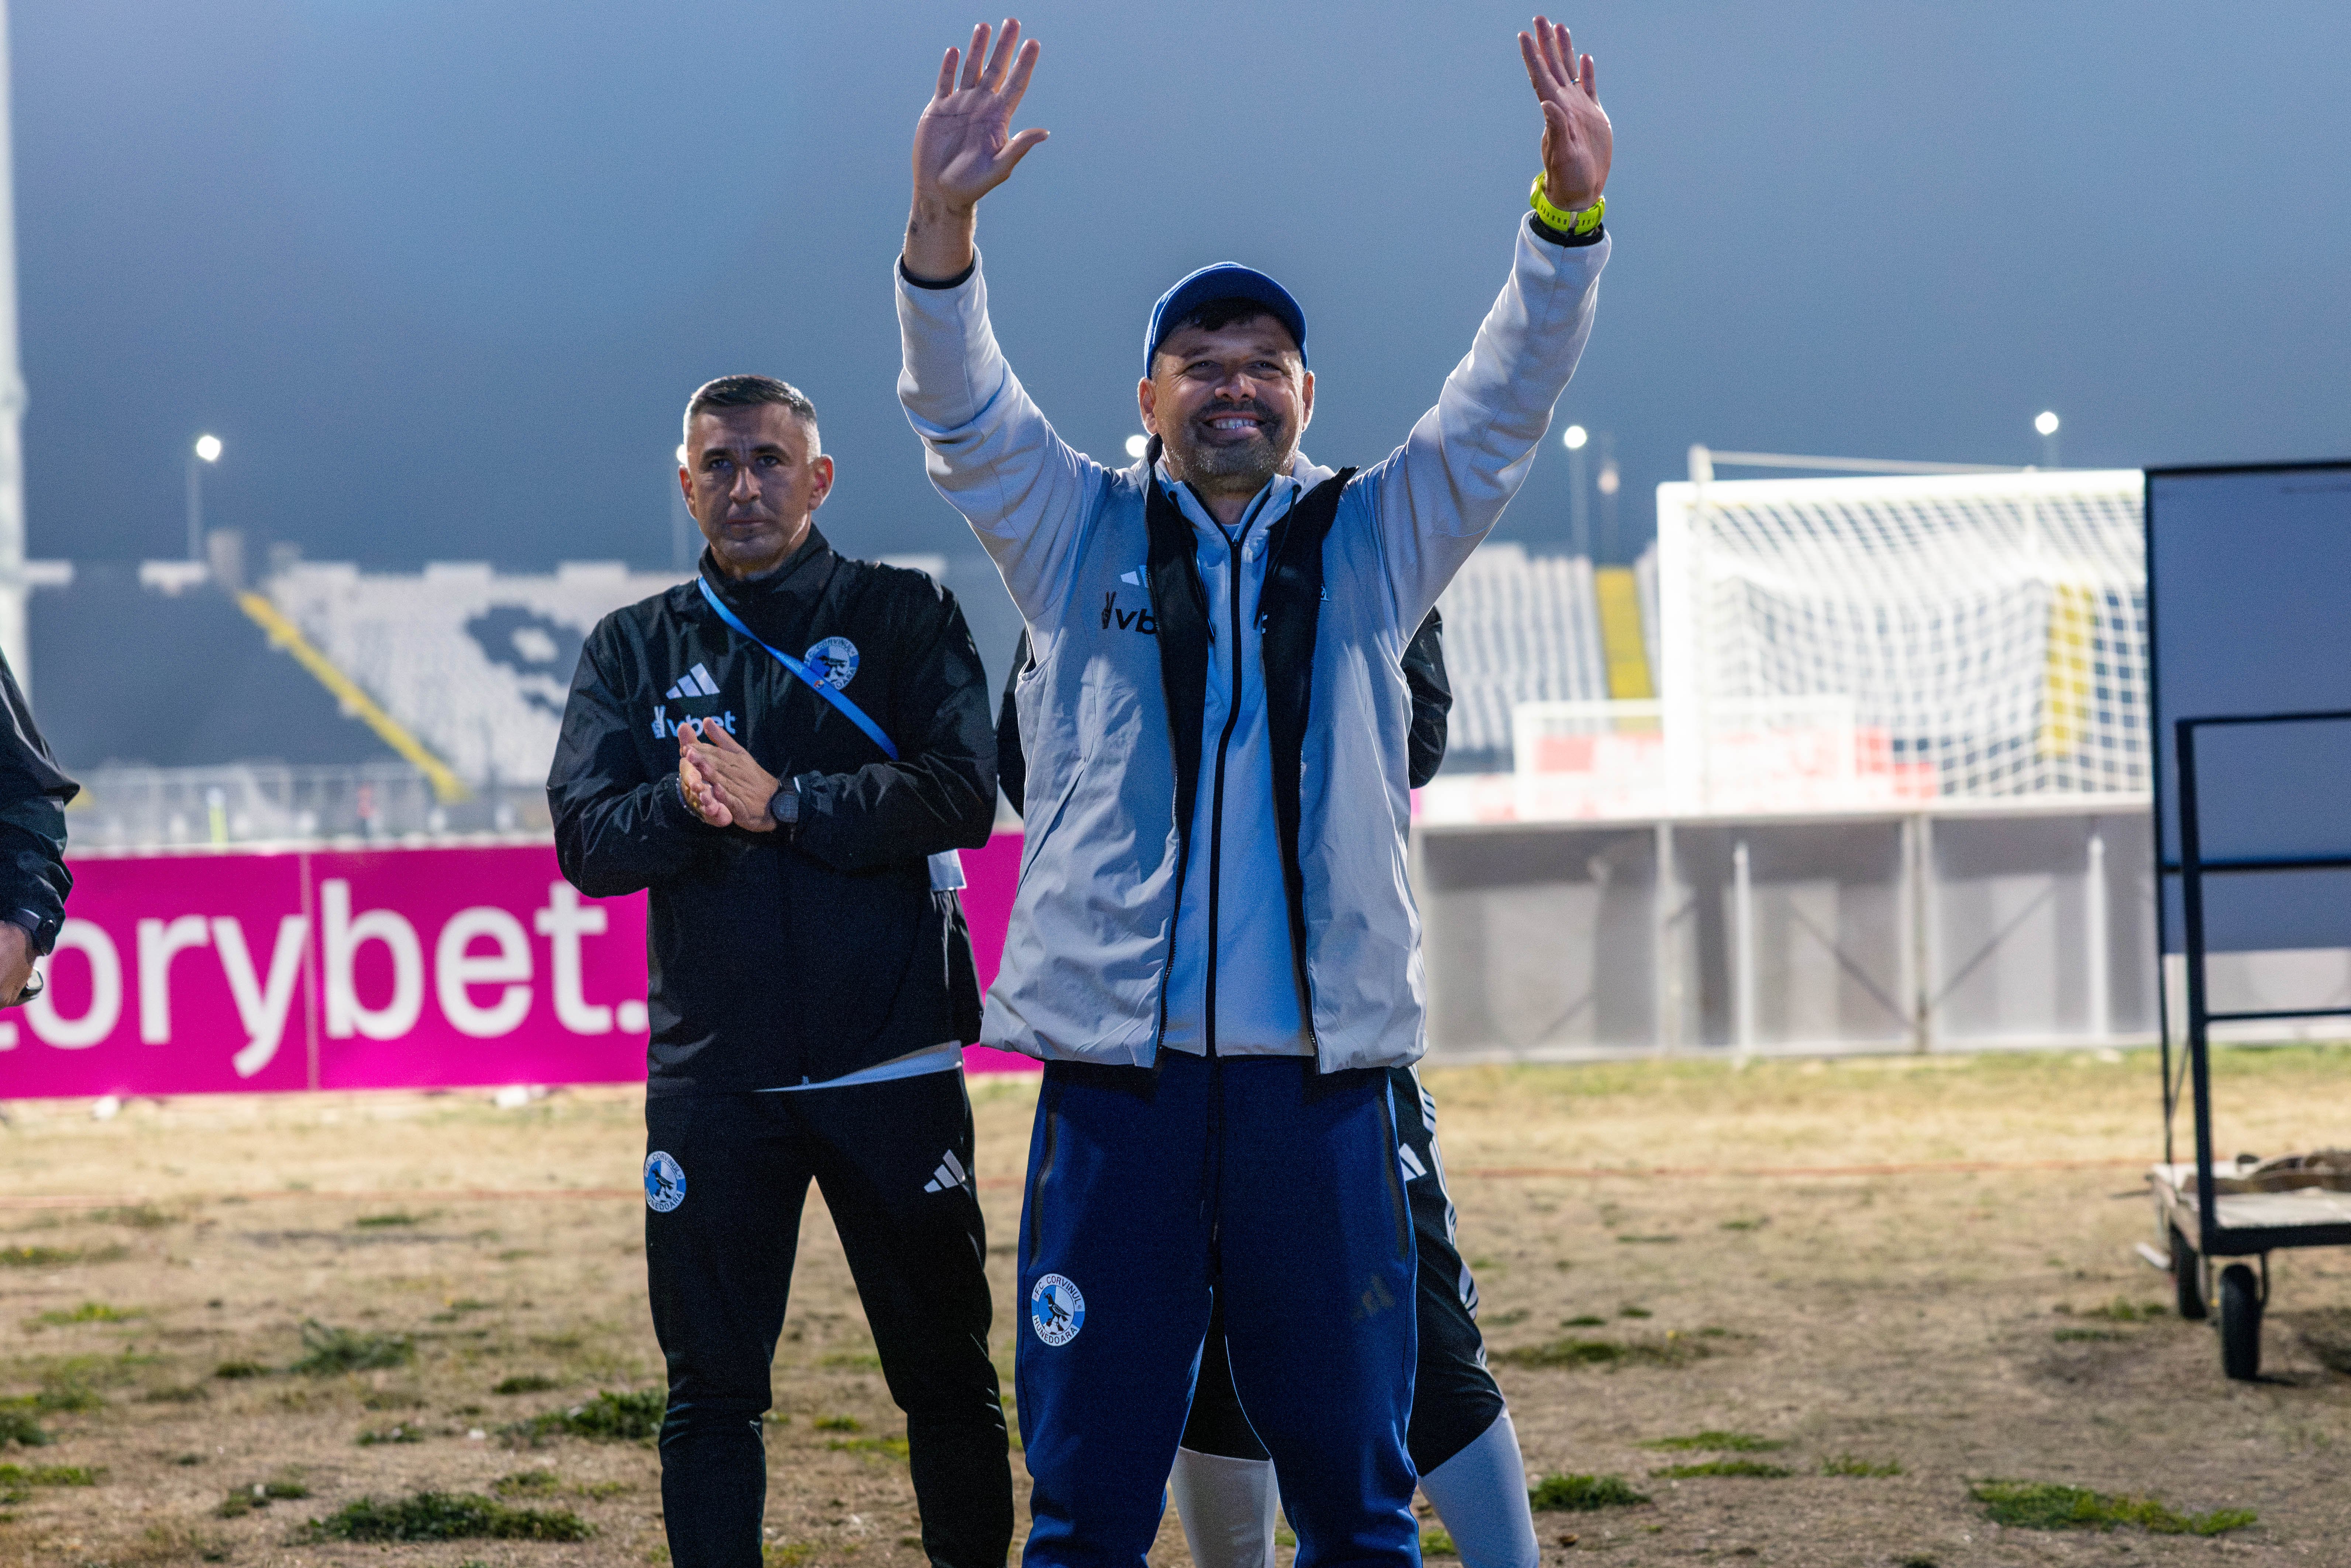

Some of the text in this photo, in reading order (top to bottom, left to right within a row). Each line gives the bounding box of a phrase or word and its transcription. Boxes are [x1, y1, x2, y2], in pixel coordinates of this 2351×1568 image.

[0, 878, 648, 1077] orybet.
[648, 1193, 682, 1210] NEDOARA
[1046, 1275, 1081, 1305] CORVINUL
[1034, 1317, 1077, 1344] HUNEDOARA
